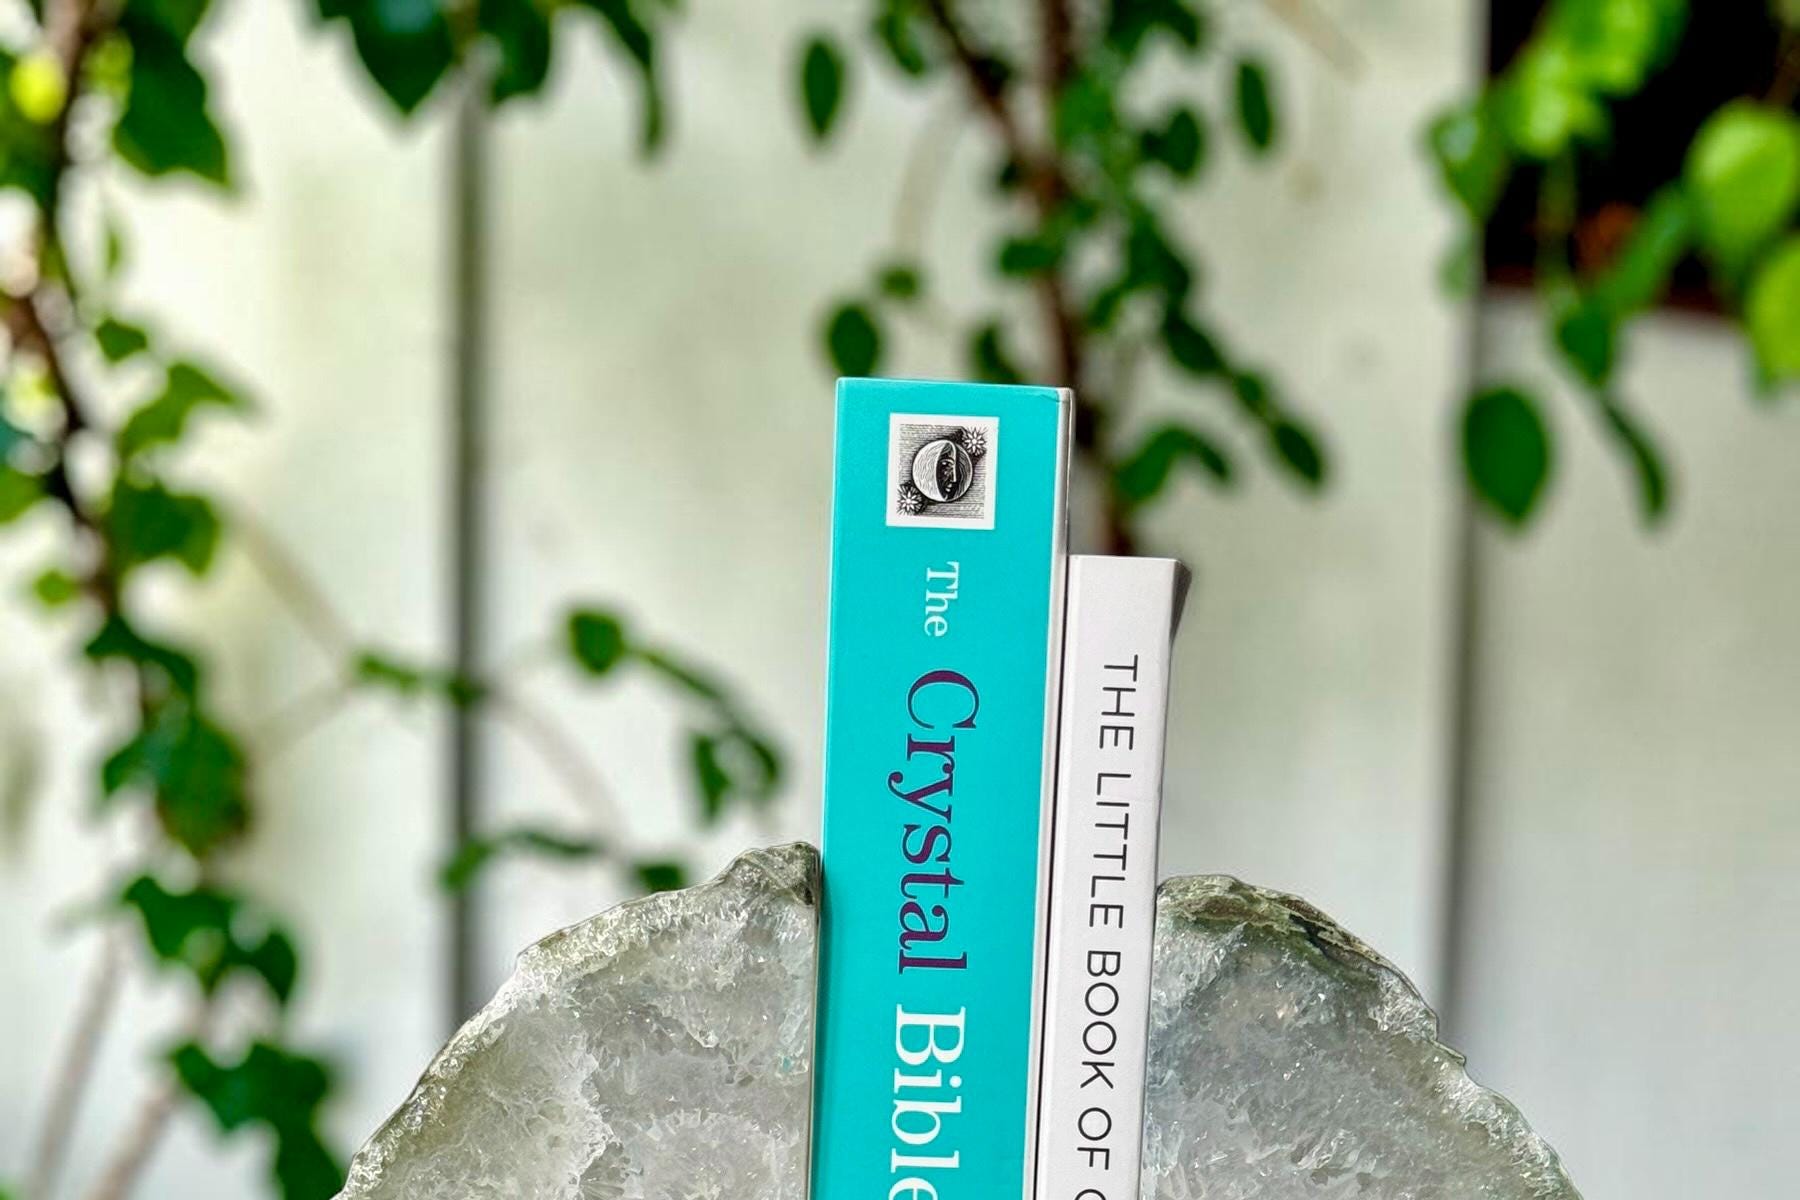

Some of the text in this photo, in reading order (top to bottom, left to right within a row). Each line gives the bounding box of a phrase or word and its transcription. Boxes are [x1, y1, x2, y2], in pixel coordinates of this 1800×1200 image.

[924, 561, 960, 637] The
[1099, 655, 1138, 750] THE
[887, 669, 979, 974] Crystal
[1088, 772, 1132, 929] LITTLE
[1079, 949, 1121, 1090] BOOK
[1076, 1106, 1113, 1171] OF
